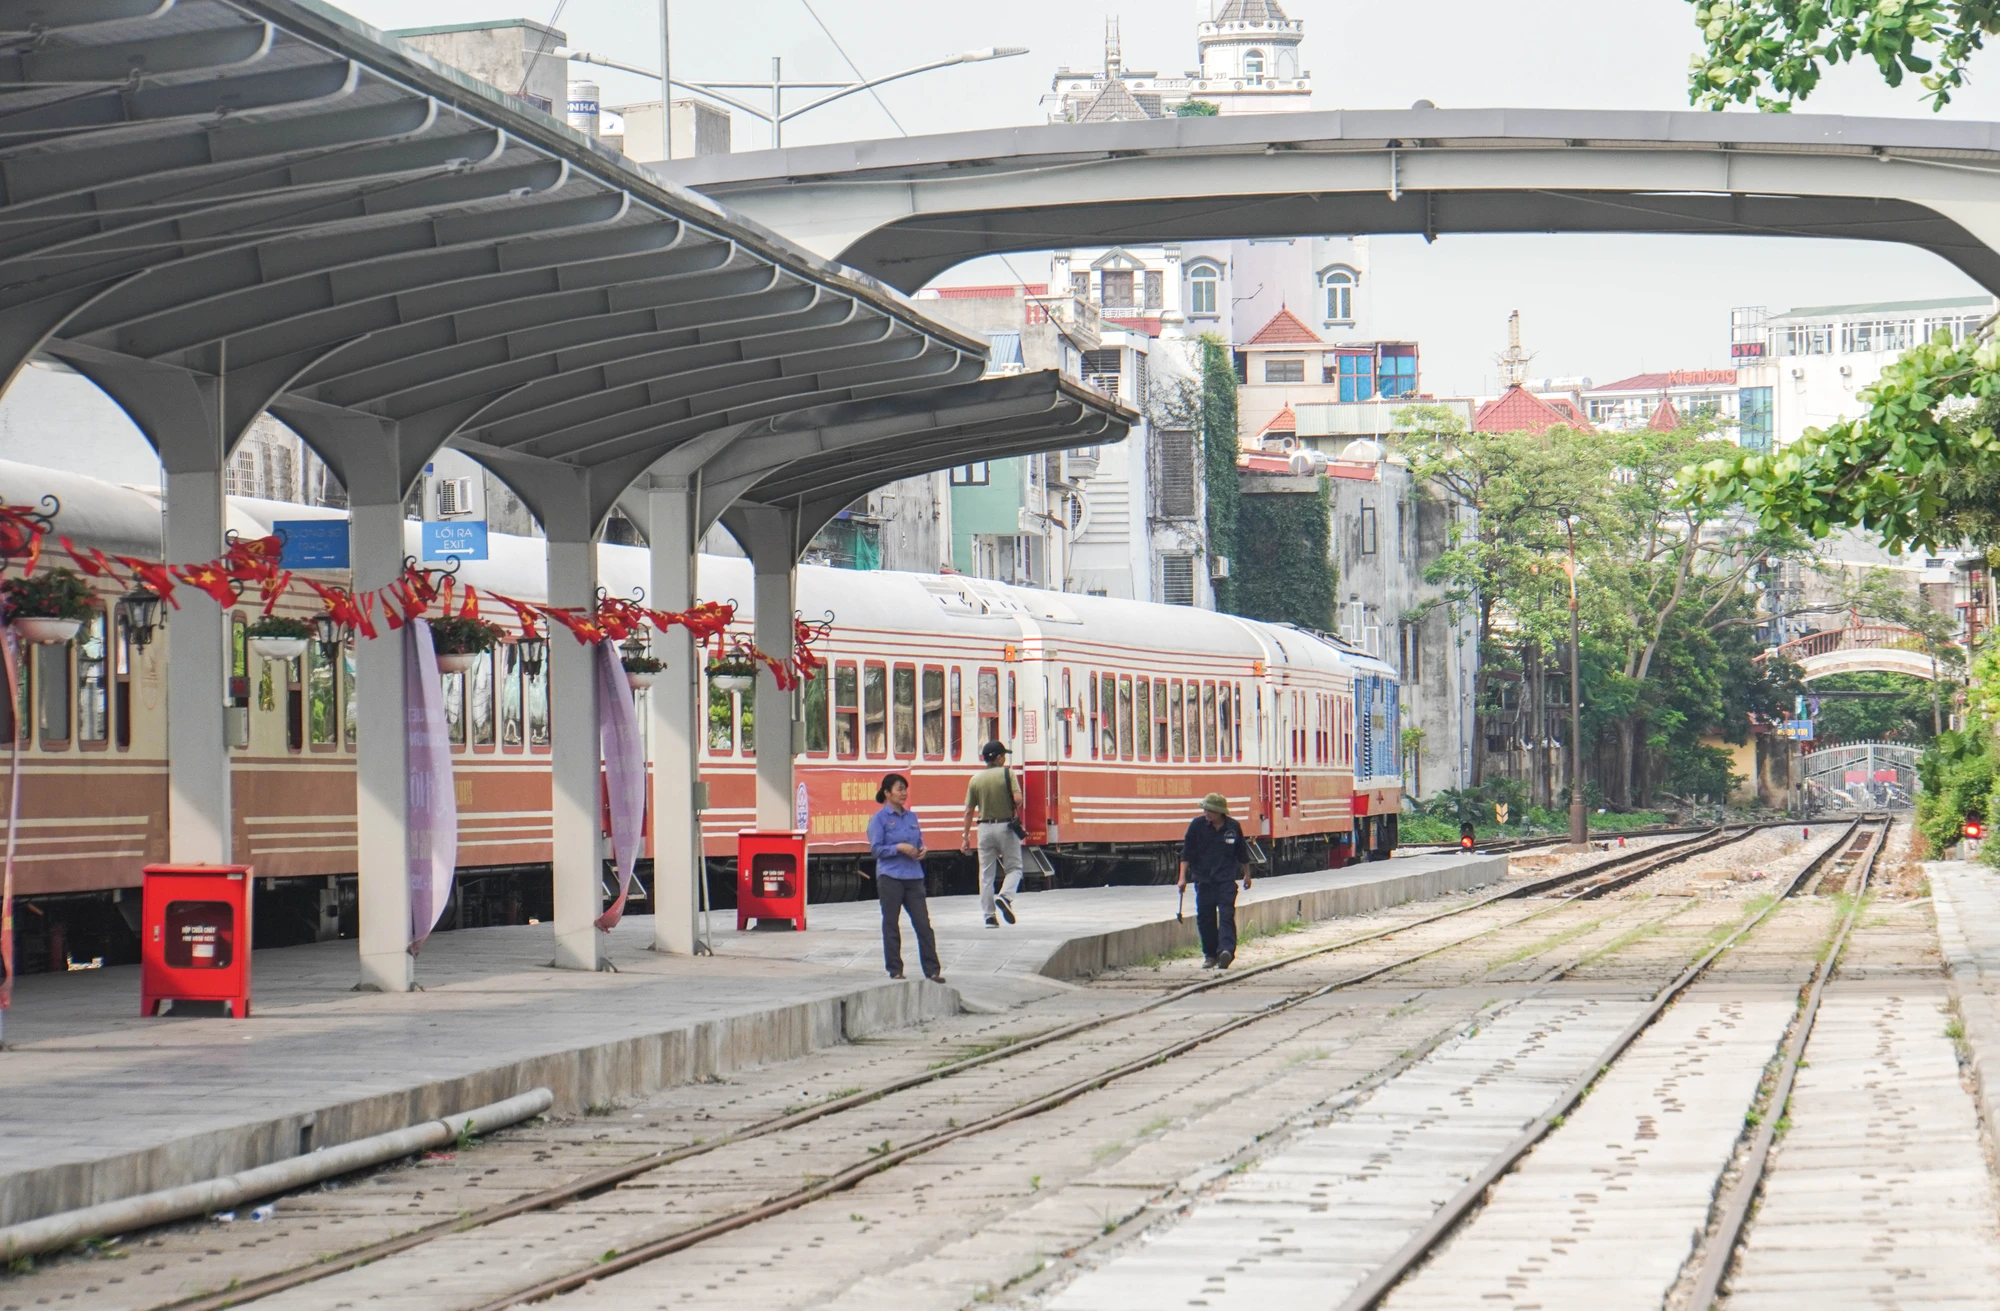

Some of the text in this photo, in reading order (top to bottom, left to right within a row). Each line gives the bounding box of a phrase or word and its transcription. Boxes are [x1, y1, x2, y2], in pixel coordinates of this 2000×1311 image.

[1732, 344, 1760, 356] GYM
[1668, 368, 1737, 385] Kienlong
[435, 526, 473, 538] LỐI RA
[443, 539, 465, 549] EXIT
